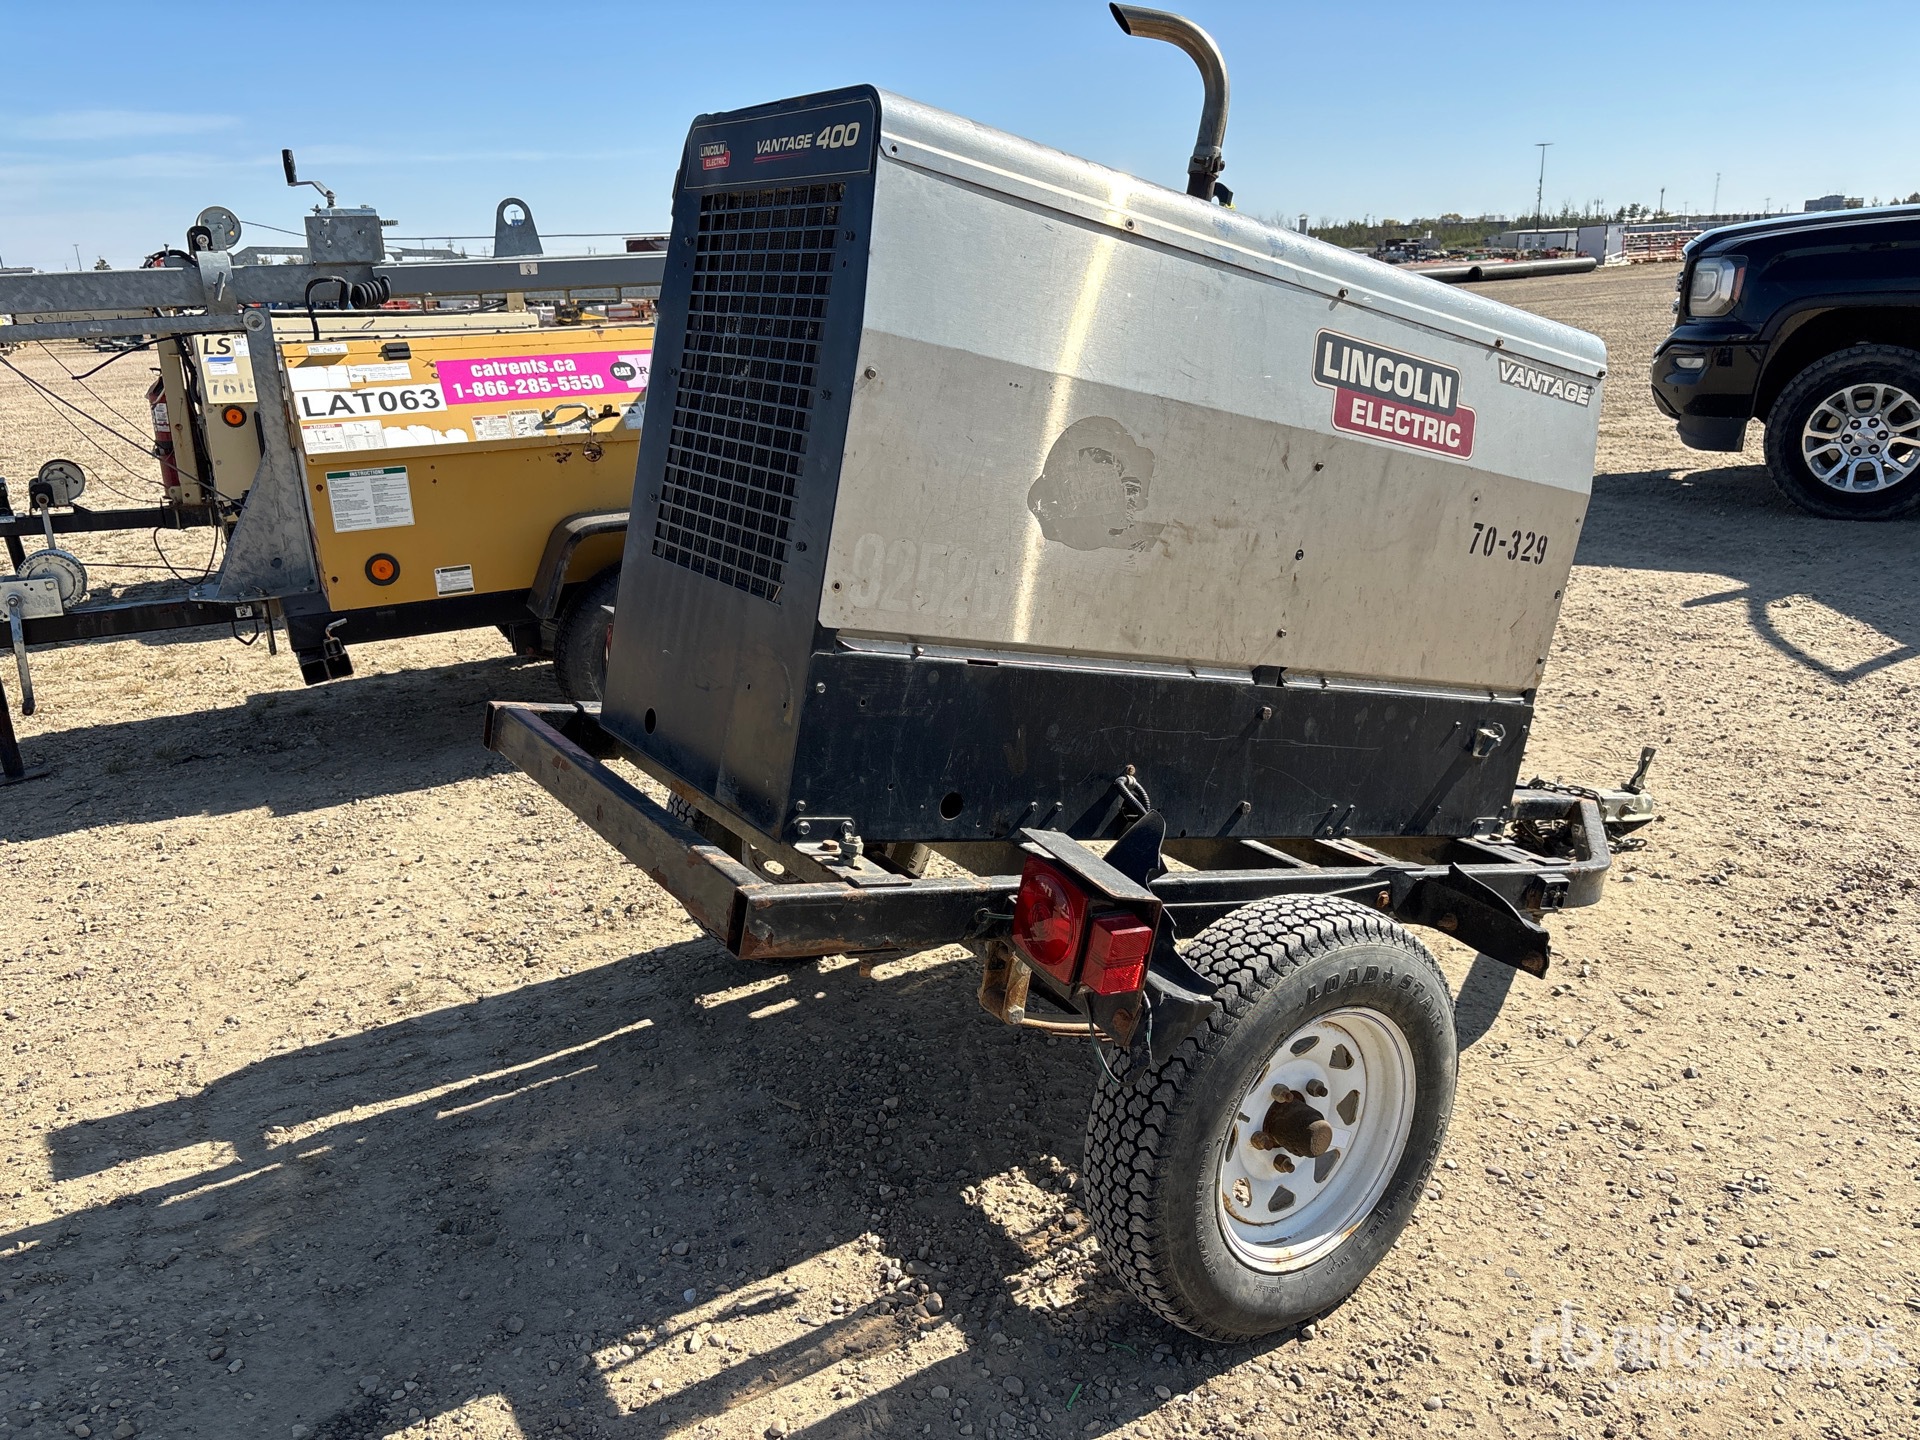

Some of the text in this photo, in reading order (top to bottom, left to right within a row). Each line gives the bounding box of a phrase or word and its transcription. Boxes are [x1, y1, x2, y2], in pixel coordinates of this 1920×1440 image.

[700, 143, 726, 158] LINCOLN
[757, 121, 861, 155] VANTAGE 400
[706, 156, 728, 168] ELECTRIC
[203, 337, 232, 356] LS
[470, 358, 577, 378] catrents.ca
[613, 365, 632, 377] CAT
[1322, 341, 1452, 409] LINCOLN
[453, 374, 605, 399] 1-866-285-5550
[1500, 361, 1592, 407] VANTAGE
[301, 388, 441, 418] LAT063
[1350, 397, 1461, 448] ELECTRIC
[349, 469, 385, 477] INSTRUCTIONS
[1469, 521, 1549, 566] 70-329
[1306, 965, 1444, 1029] LOAD STAR
